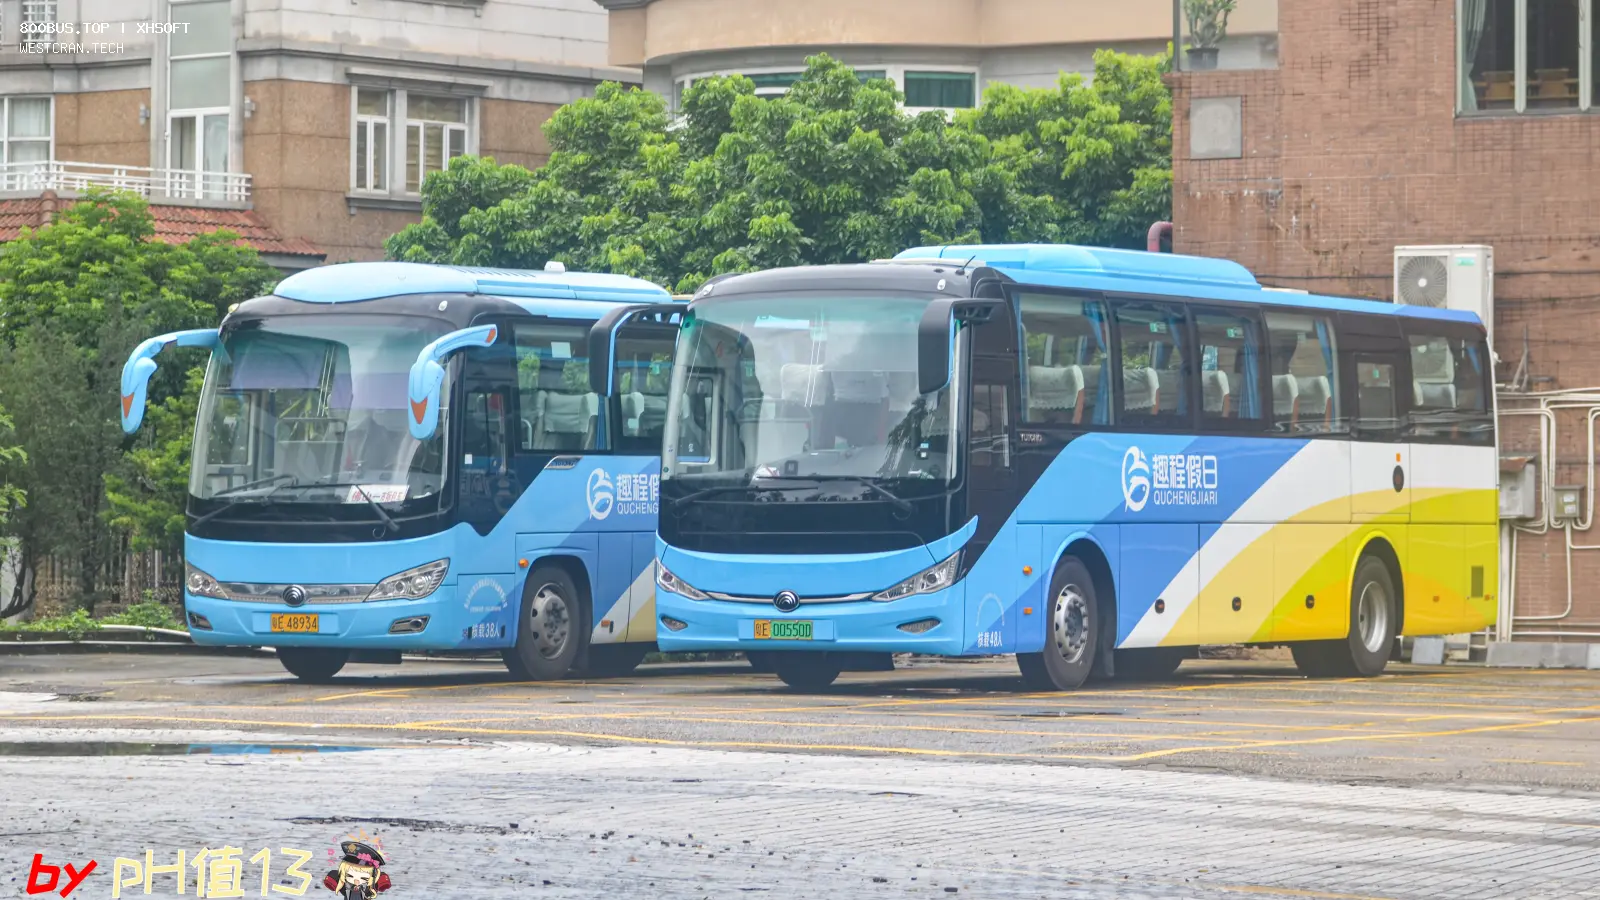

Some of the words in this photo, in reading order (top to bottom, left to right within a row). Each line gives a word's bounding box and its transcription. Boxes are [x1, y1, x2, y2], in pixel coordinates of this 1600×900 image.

[1152, 454, 1218, 489] 趣程假日
[1153, 490, 1218, 505] QUCHENGJIARI
[617, 502, 659, 515] QUCHENG
[286, 615, 317, 630] 48934
